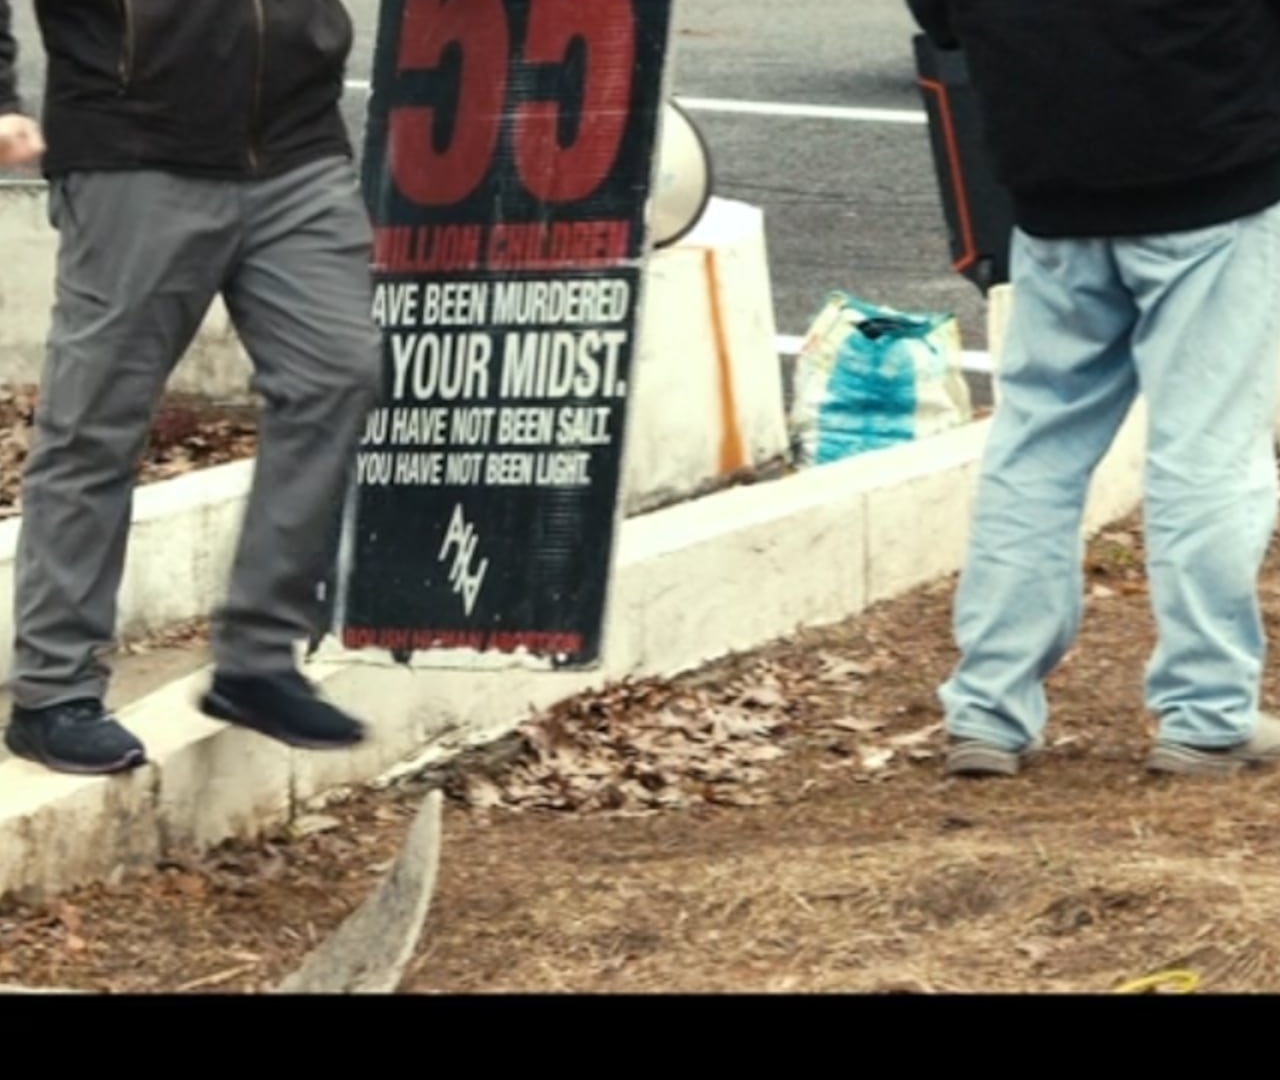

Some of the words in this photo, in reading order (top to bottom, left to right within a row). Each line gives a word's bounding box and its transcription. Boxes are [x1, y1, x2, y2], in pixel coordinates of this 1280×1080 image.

[487, 219, 630, 270] CHILDREN
[371, 283, 419, 326] AVE
[422, 282, 488, 326] BEEN
[492, 279, 630, 325] MURDERED
[391, 332, 493, 400] YOUR
[499, 330, 628, 398] MIDST.
[390, 407, 449, 446] HAVE
[450, 407, 497, 446] NOT
[497, 407, 554, 446] BEEN
[556, 406, 612, 445] SALT.
[355, 452, 394, 486] YOU
[393, 452, 445, 486] HAVE
[444, 452, 485, 486] NOT
[484, 452, 535, 486] BEEN
